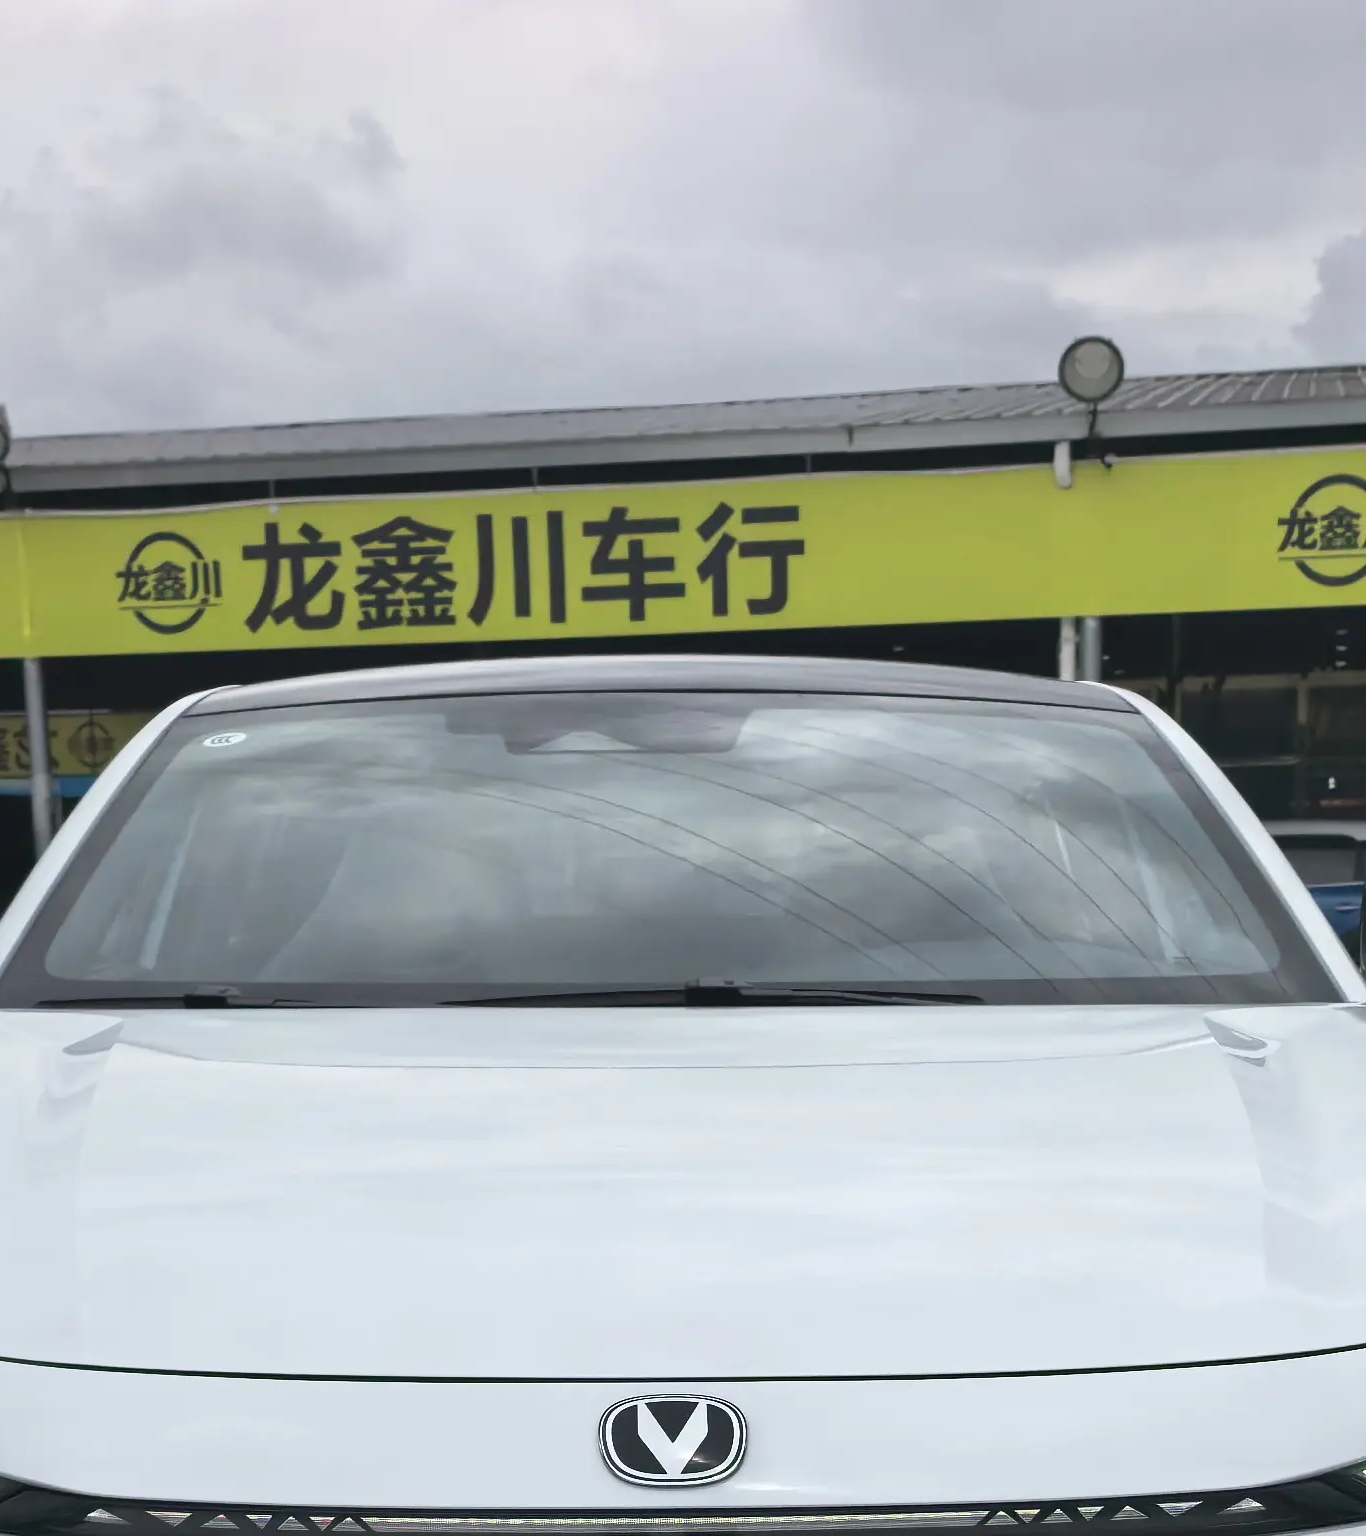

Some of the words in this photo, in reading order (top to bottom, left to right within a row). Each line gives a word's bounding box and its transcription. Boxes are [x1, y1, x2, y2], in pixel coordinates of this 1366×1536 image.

[115, 559, 222, 602] 龙鑫川
[241, 501, 805, 633] 龙鑫川车行
